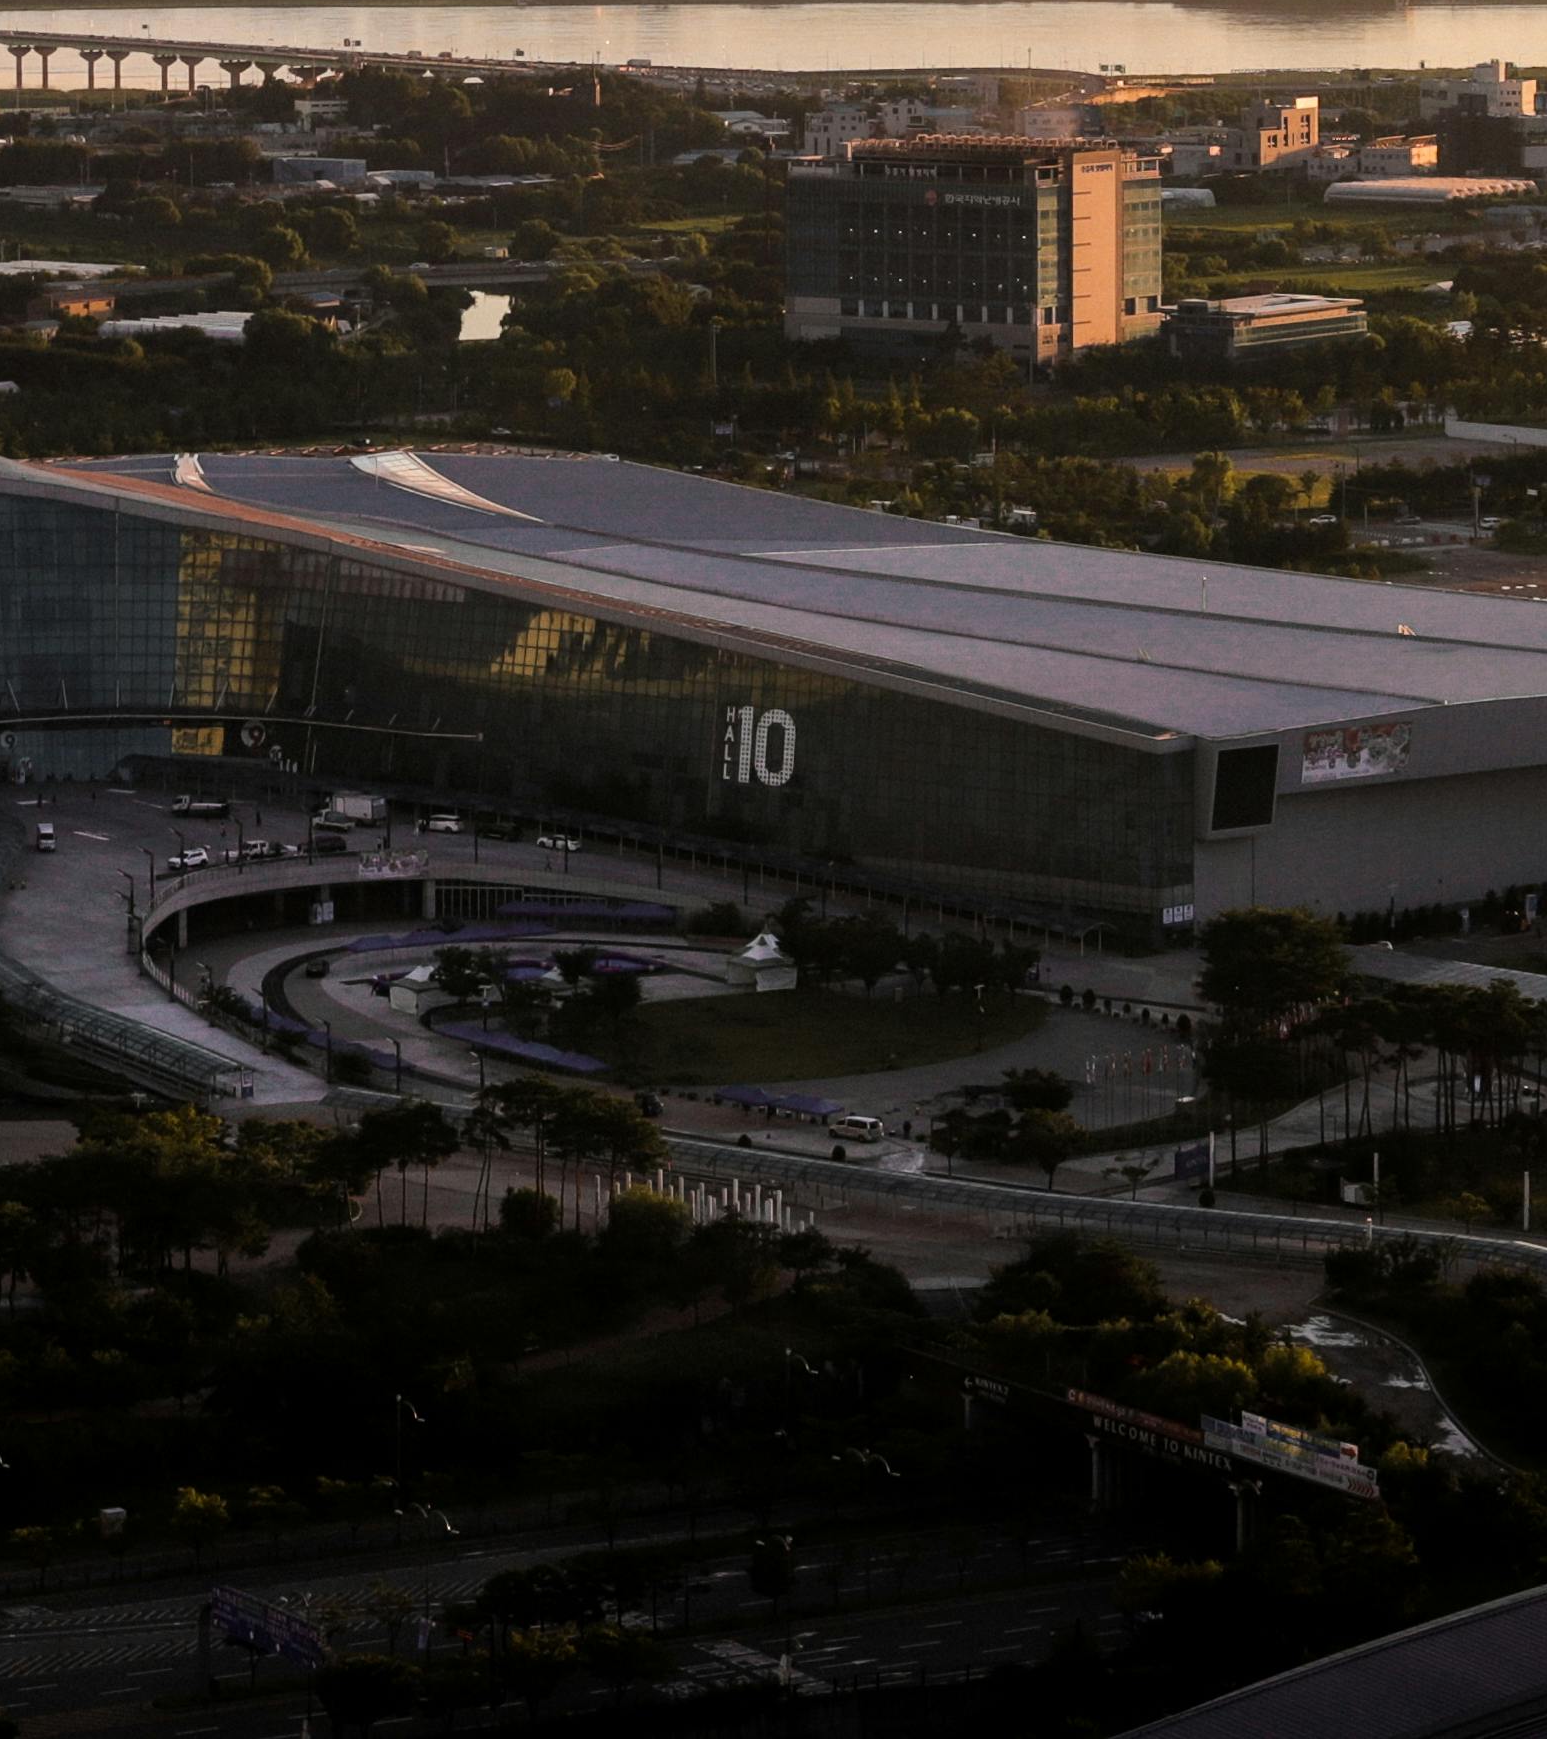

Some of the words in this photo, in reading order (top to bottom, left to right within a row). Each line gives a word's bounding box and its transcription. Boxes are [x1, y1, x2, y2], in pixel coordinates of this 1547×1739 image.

[5, 733, 16, 749] 9
[722, 705, 737, 781] HALL
[737, 705, 797, 787] 10
[1092, 1414, 1158, 1447] WELCOME
[1163, 1437, 1180, 1454] TO
[1183, 1444, 1233, 1472] KINTEX
